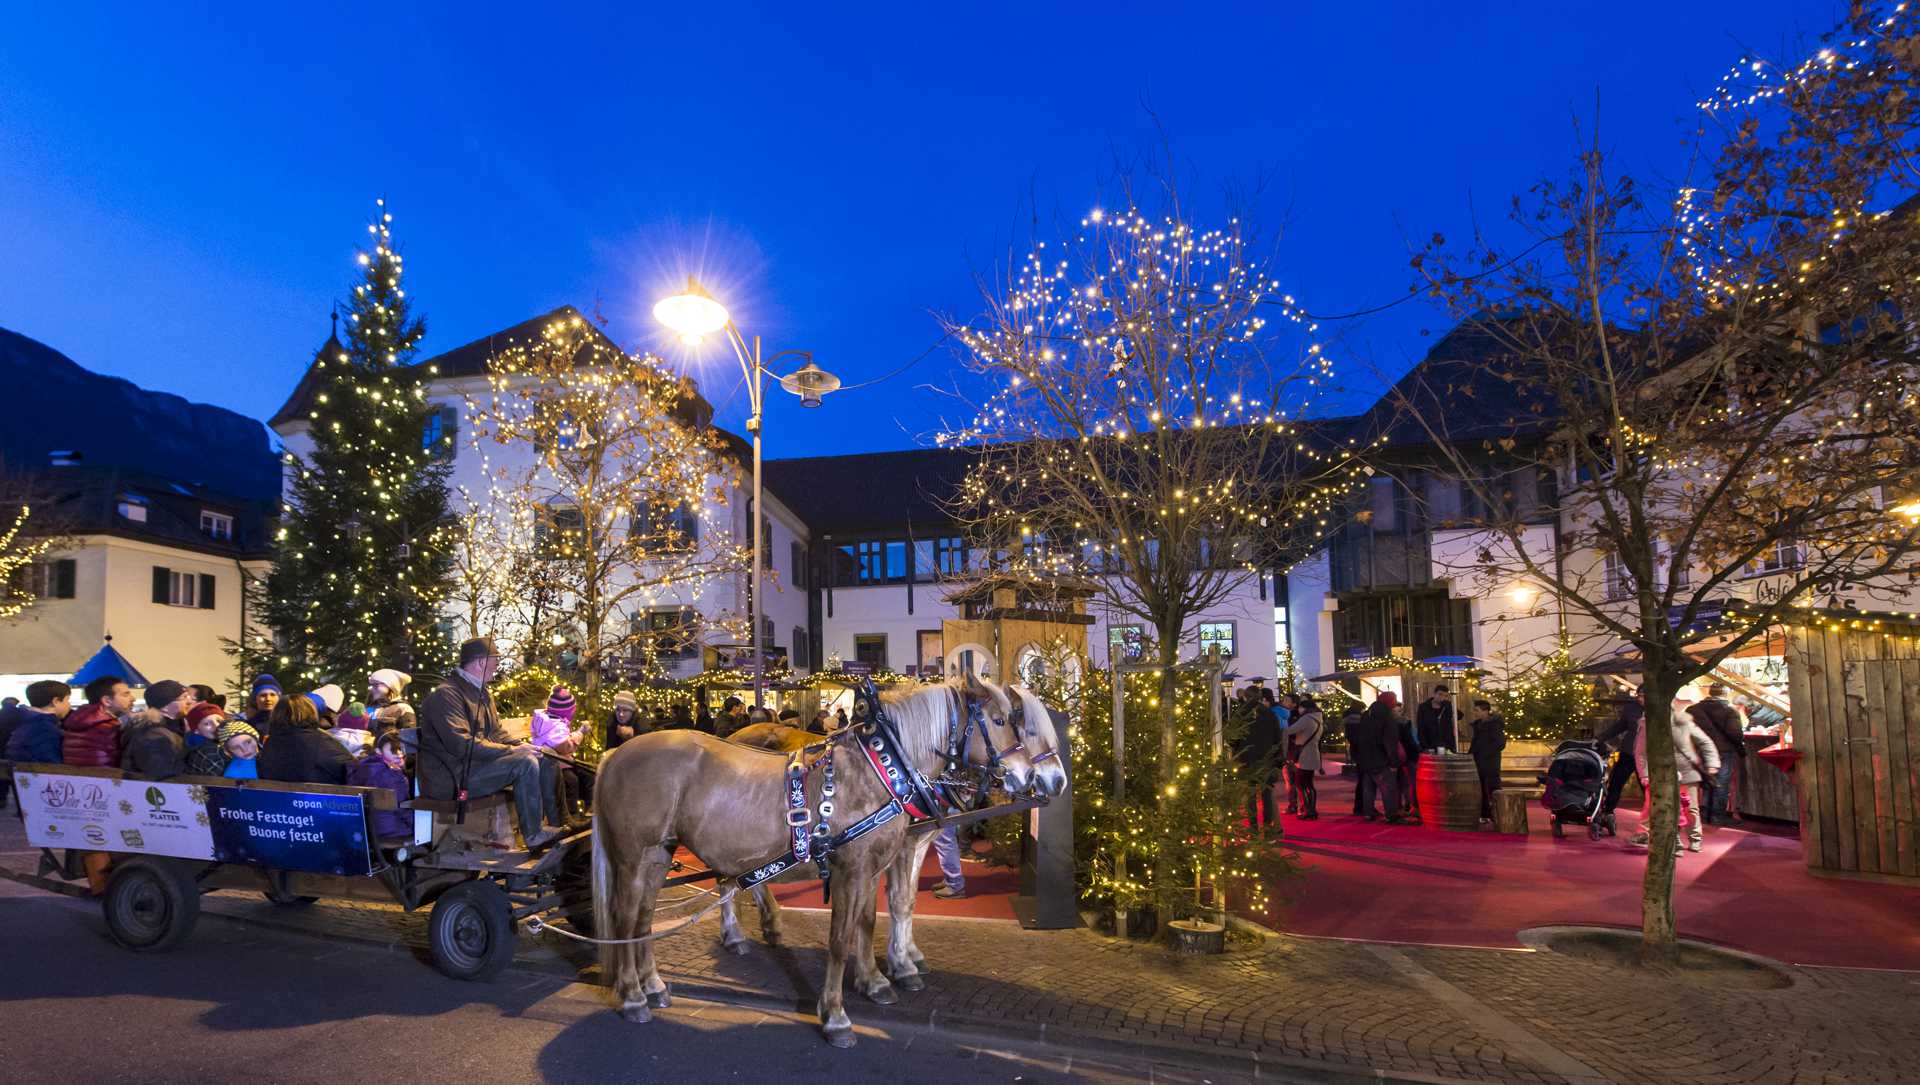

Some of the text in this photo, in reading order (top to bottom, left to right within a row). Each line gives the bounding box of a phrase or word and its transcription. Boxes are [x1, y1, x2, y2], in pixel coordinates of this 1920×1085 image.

[219, 807, 315, 828] Frohe Festtage!
[248, 825, 325, 843] Buone feste!
